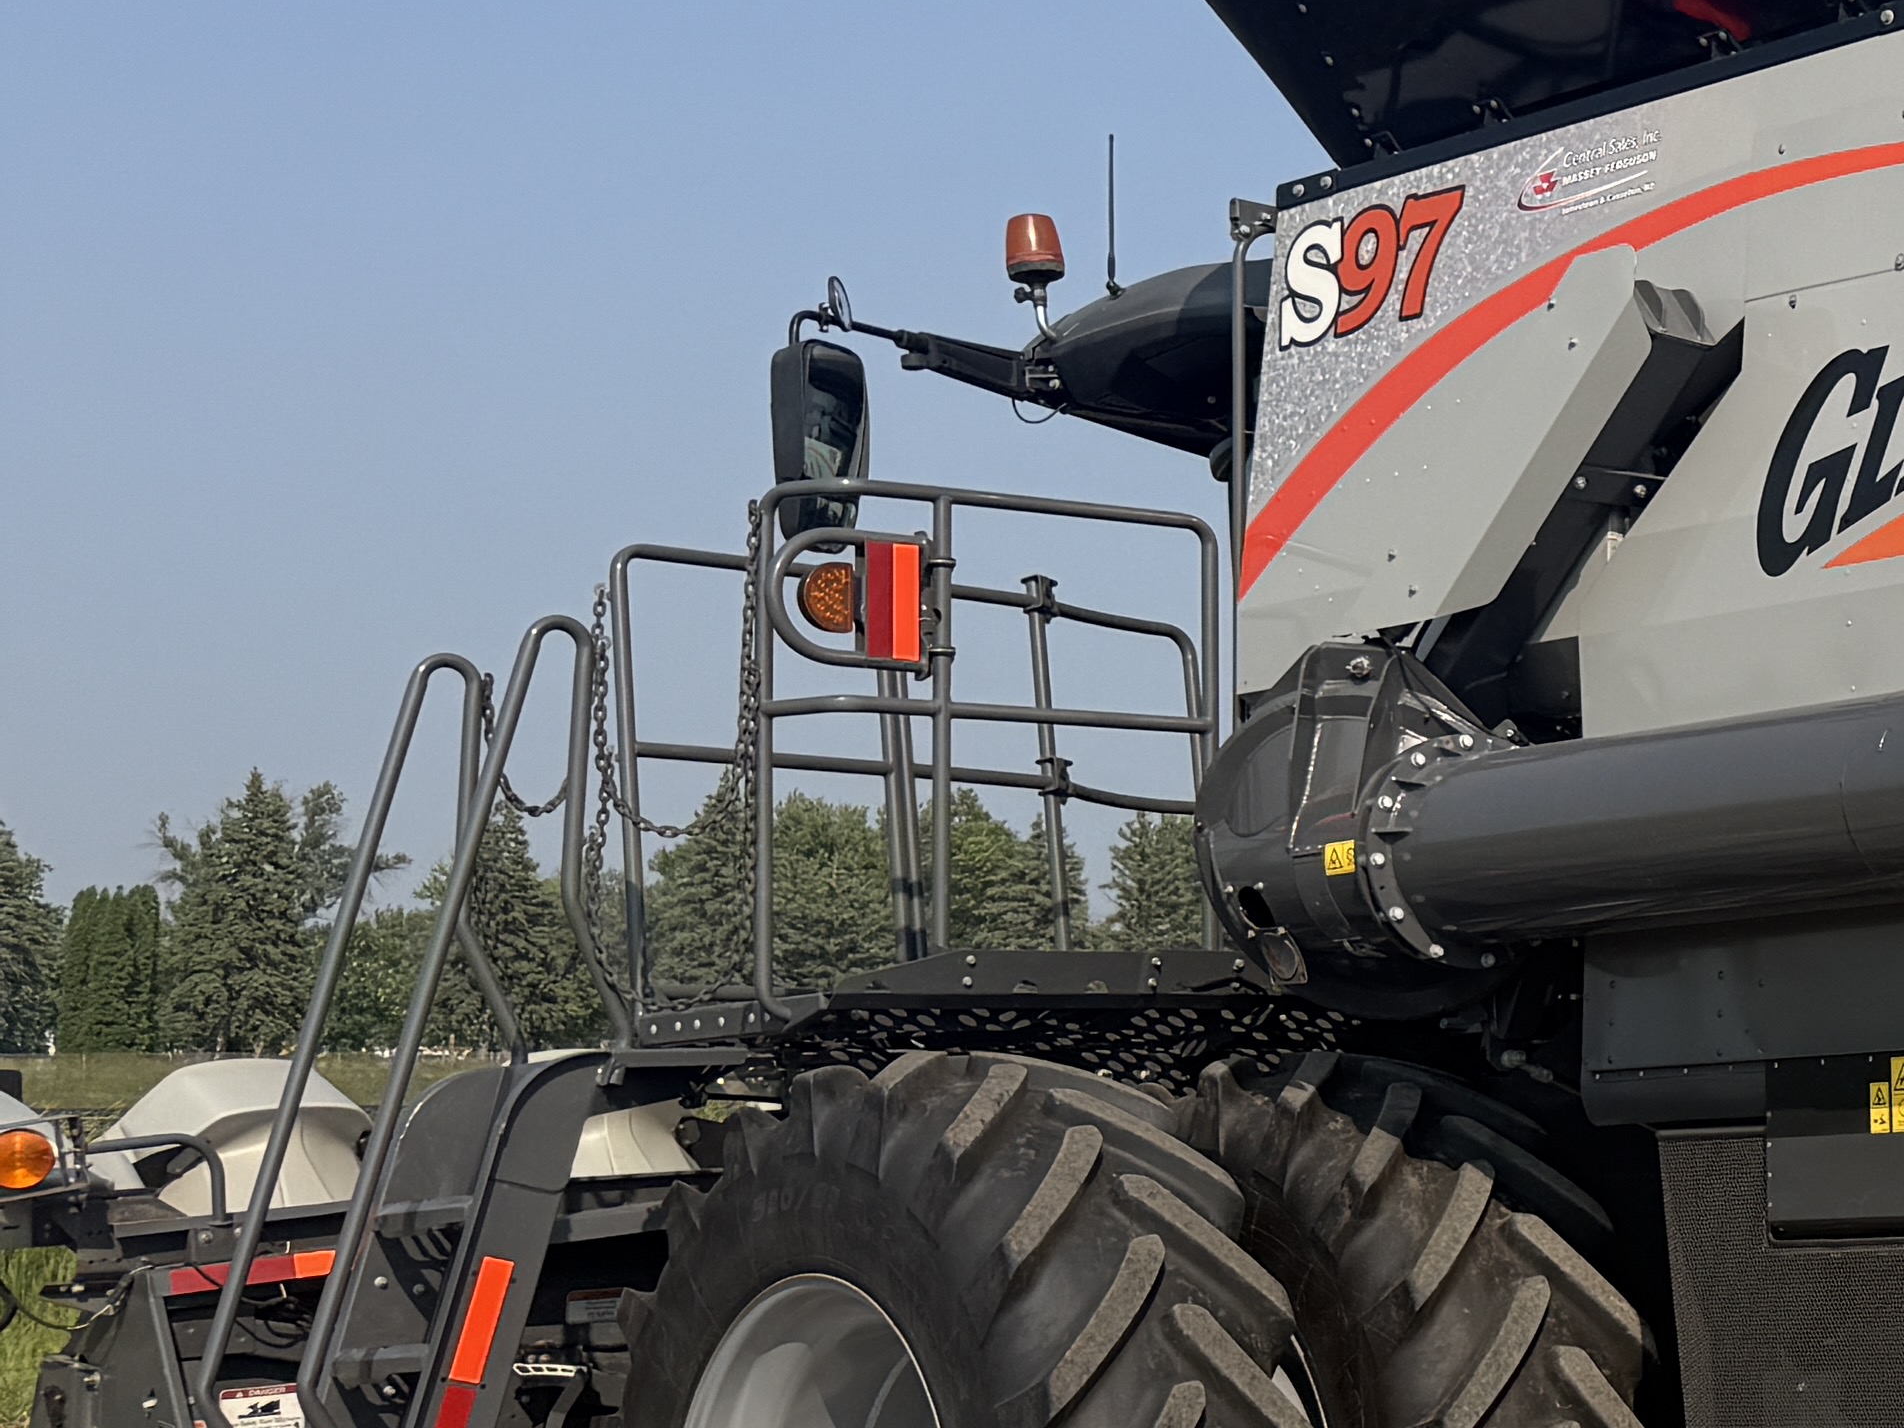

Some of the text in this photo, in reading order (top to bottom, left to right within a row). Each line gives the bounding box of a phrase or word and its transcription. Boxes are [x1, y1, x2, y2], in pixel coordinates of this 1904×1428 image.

[1561, 151, 1657, 186] MASSEY FERGUSON
[1563, 141, 1607, 169] Central
[1279, 184, 1466, 352] S97
